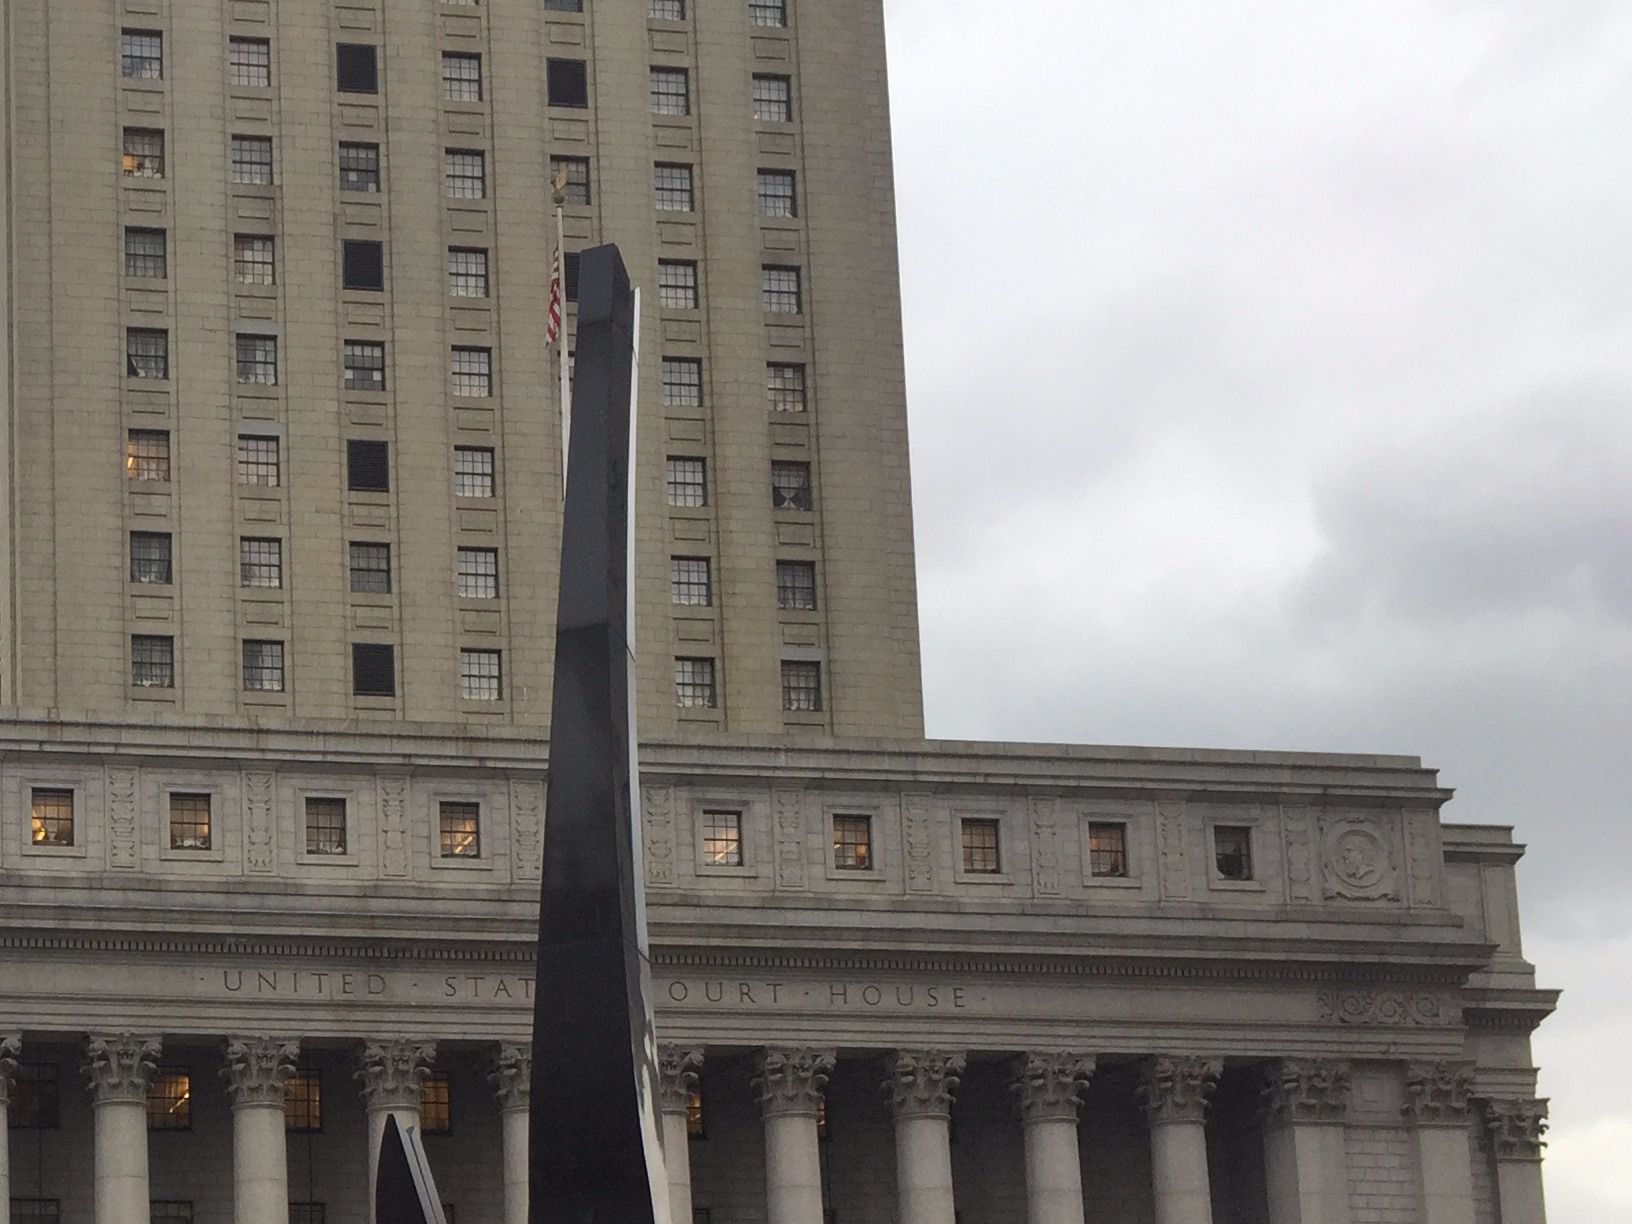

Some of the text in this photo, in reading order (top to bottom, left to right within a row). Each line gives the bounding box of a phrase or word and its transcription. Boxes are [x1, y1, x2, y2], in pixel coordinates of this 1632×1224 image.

[223, 970, 965, 1008] UNITED STAT OURT HOUSE
